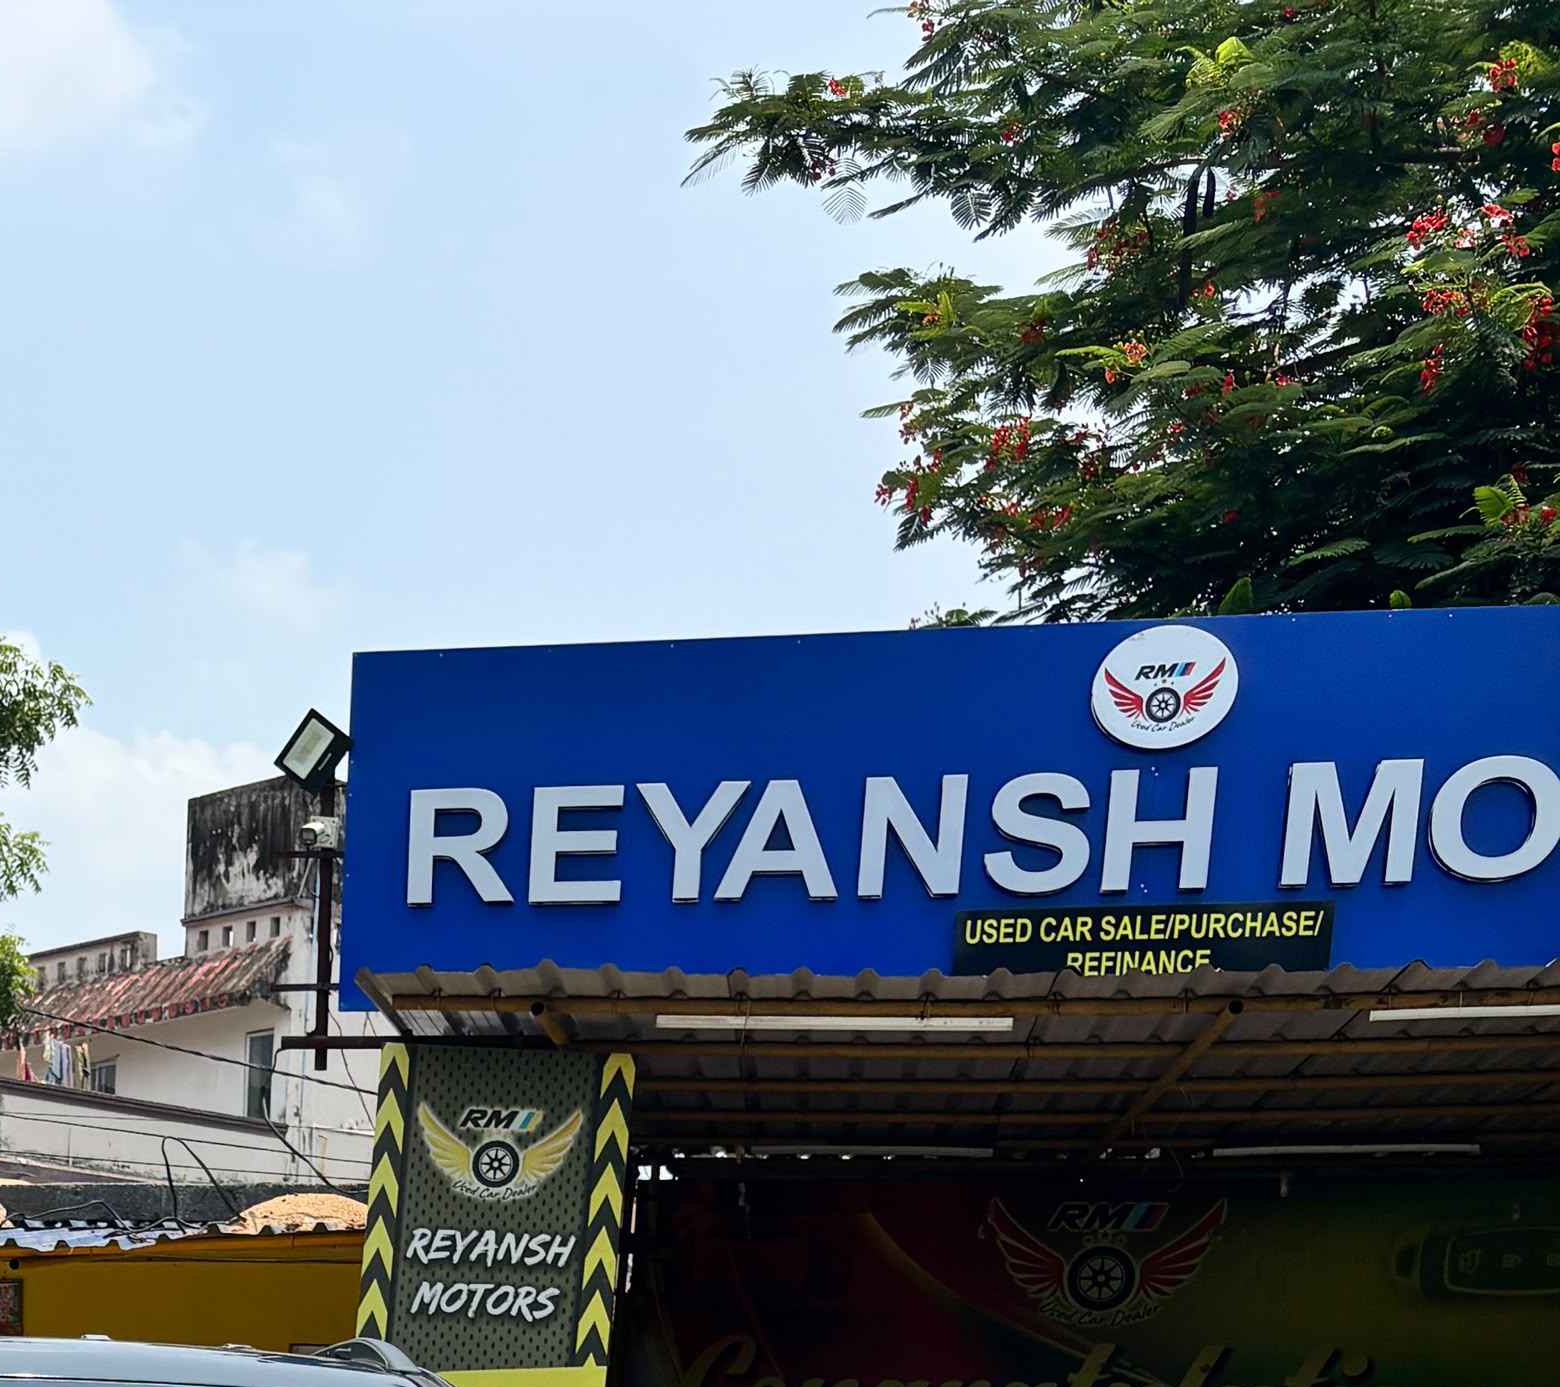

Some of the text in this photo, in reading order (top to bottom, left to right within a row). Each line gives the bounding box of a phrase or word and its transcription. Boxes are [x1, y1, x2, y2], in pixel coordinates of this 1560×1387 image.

[1130, 716, 1195, 732] Used Car Dealer
[407, 755, 1560, 906] REYANSH MO
[965, 910, 1324, 944] USED CAR SALE/PURCHASE/
[452, 1180, 537, 1200] Used Car Dealer
[406, 1227, 576, 1268] REYANSH
[410, 1281, 561, 1322] MOTORS
[1040, 1303, 1160, 1327] Used Car Dealer
